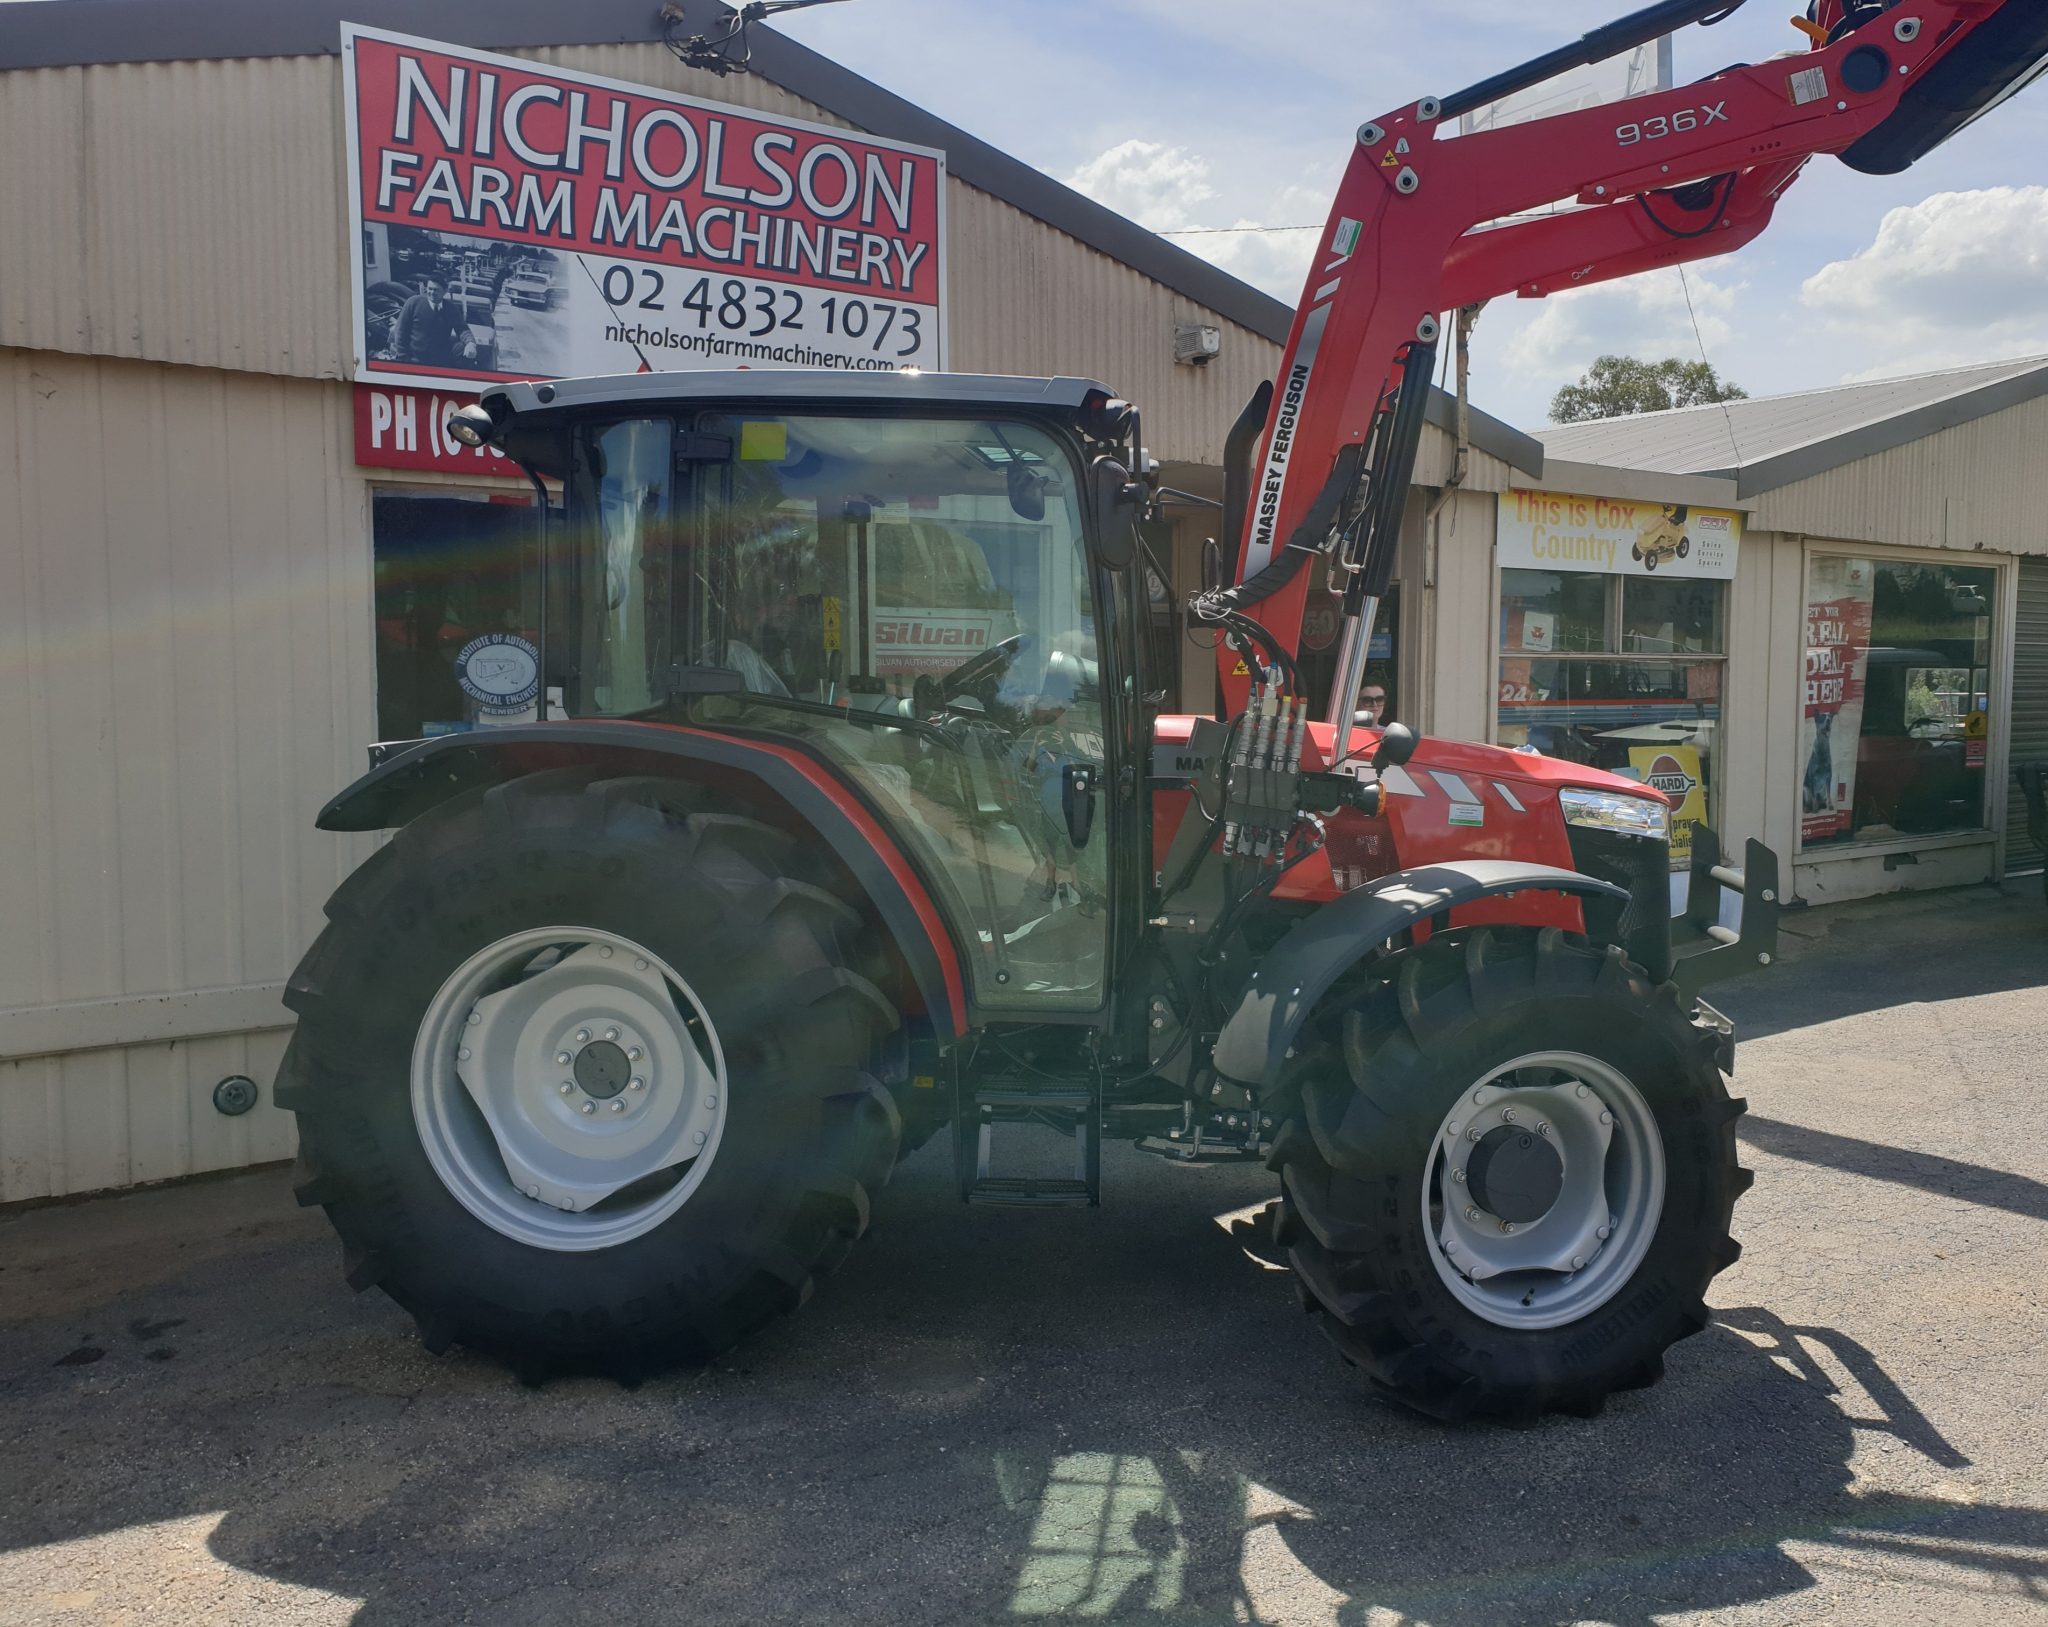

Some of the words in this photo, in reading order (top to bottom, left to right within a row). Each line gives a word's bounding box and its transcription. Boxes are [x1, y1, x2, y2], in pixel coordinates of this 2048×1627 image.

[392, 54, 915, 233] NICHOLSON
[1615, 100, 1729, 146] 936X
[377, 147, 576, 239] FARM
[591, 186, 929, 293] MACHINERY
[602, 264, 665, 311] 02
[682, 277, 804, 337] 4832
[820, 296, 922, 357] 1073
[605, 321, 921, 371] nicholsonfarmmachinery.com
[371, 391, 417, 452] PH
[1256, 468, 1283, 545] MASSEY
[1271, 364, 1309, 464] FERGUSON
[1513, 489, 1561, 527] This
[1568, 494, 1588, 527] is
[1594, 498, 1635, 530] Cox
[1532, 524, 1618, 570] Country
[457, 635, 490, 665] INSTITUTE
[492, 634, 503, 644] OF
[505, 634, 539, 663] AUTOMOT
[875, 621, 986, 646] Silvan
[1807, 620, 1849, 646] REAL
[1806, 651, 1845, 675] DEAL
[458, 677, 503, 705] MECHANICAL
[506, 678, 538, 705] ENGINEE
[481, 705, 528, 715] MEMBER
[1652, 777, 1685, 791] HARDI
